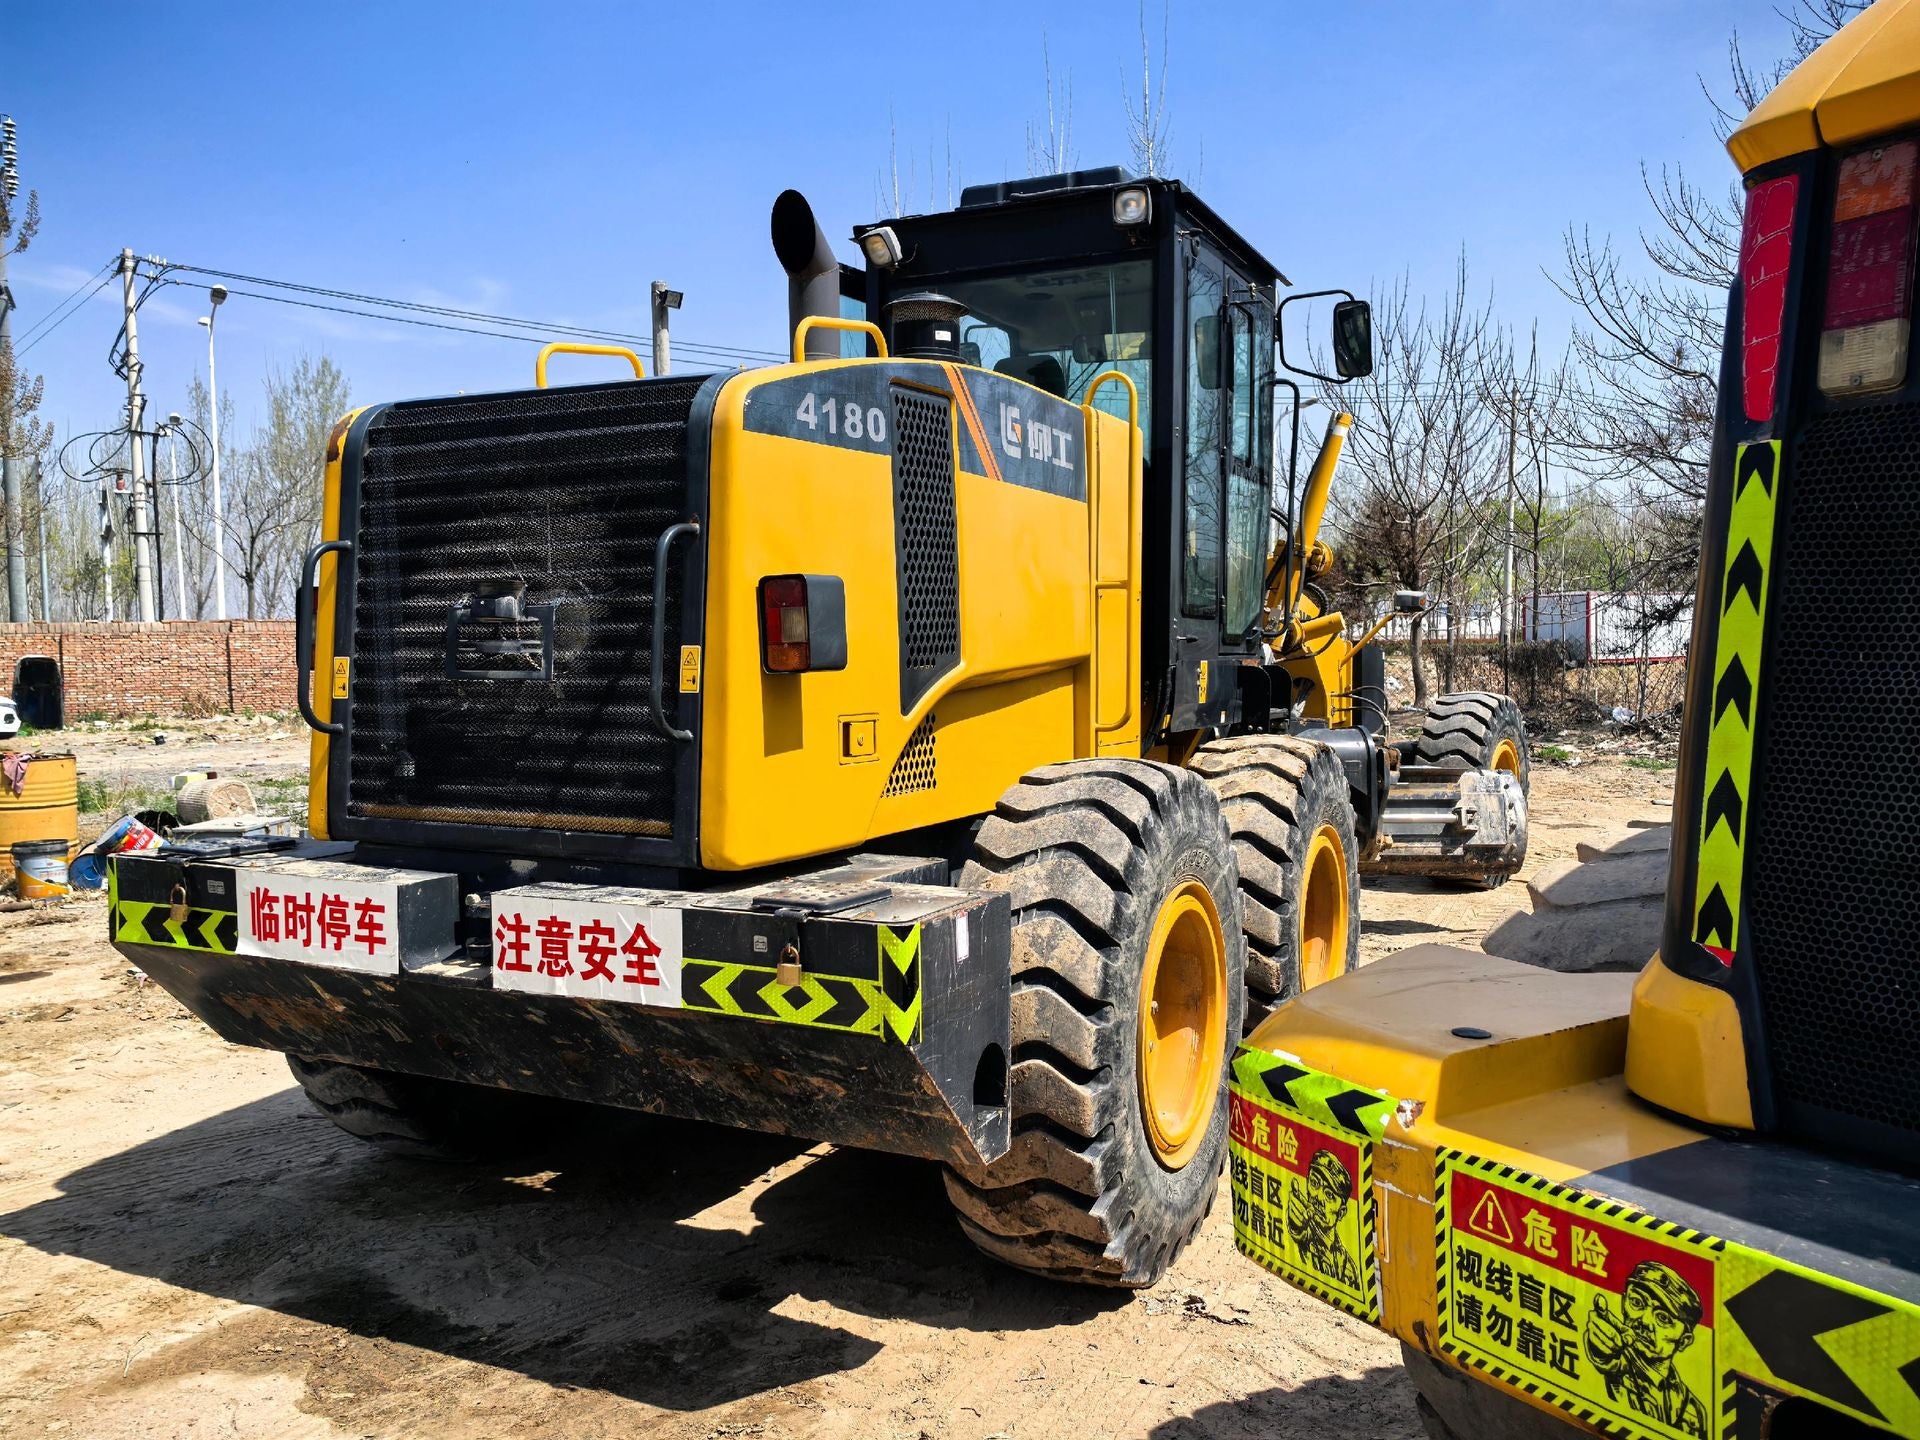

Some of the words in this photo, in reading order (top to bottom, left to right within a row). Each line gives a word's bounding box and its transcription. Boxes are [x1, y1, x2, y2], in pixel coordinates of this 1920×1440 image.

[797, 392, 886, 442] 4180
[1027, 419, 1074, 471] 柳工
[250, 886, 387, 956] 临时停车
[495, 912, 662, 987] 注意安全
[1251, 1112, 1299, 1166] 危险
[1521, 1208, 1609, 1279] 危险
[1456, 1245, 1578, 1332] 视线盲区
[1456, 1290, 1580, 1381] 请勿靠近
